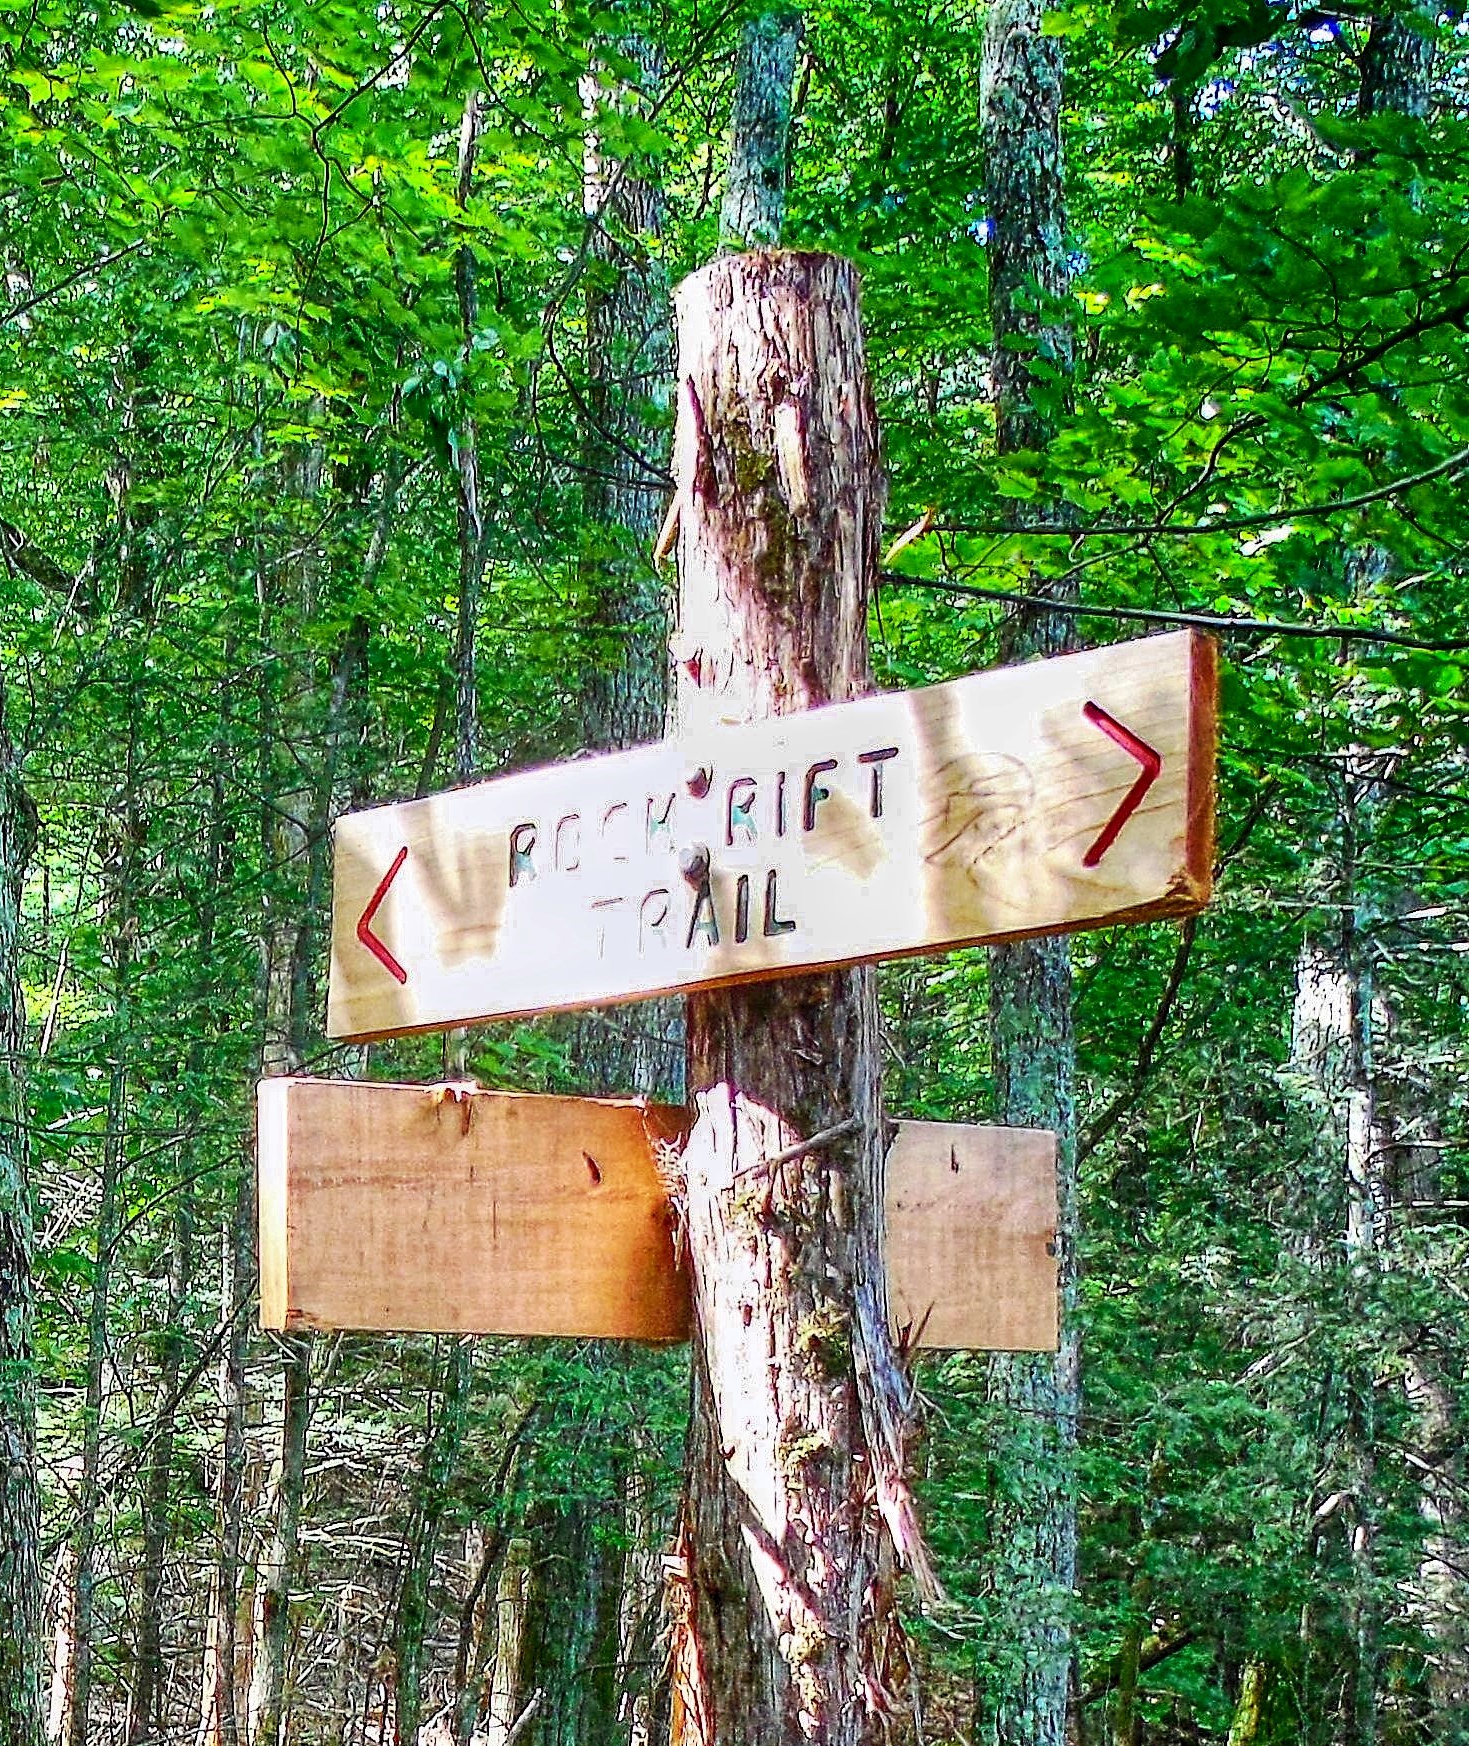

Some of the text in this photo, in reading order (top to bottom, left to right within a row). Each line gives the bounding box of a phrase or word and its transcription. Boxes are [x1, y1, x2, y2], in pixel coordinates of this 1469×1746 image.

[509, 747, 899, 888] ROCK RIFT
[590, 868, 797, 958] TRAIL
